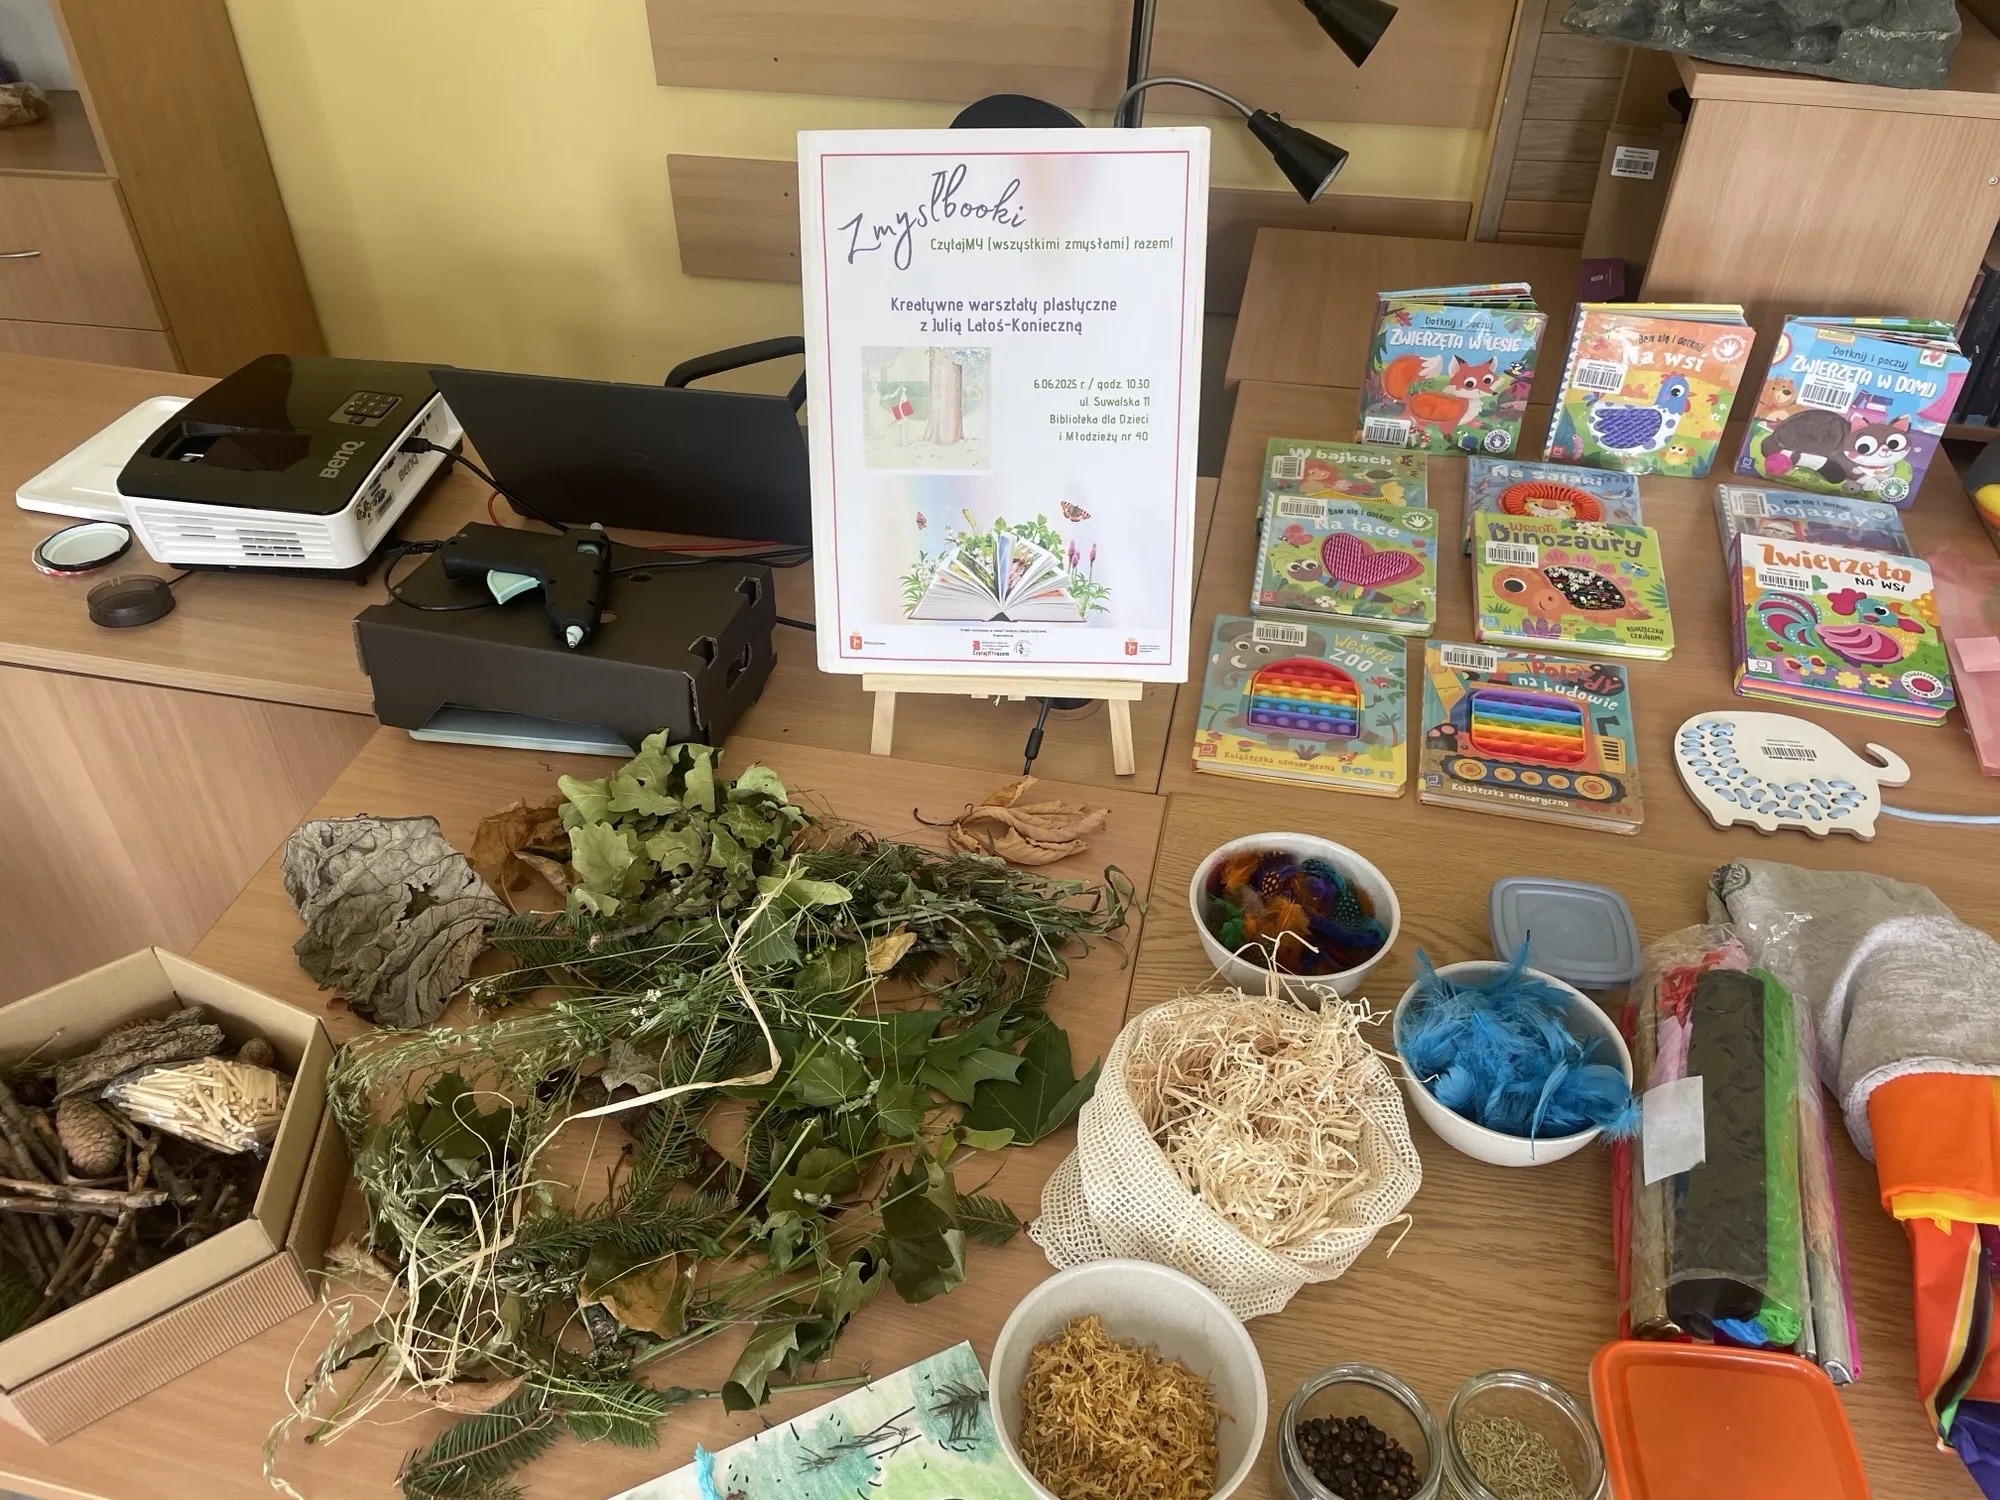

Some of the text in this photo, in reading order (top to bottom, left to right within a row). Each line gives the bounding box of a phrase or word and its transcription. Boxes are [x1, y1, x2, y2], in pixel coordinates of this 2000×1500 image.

[930, 236, 1174, 253] CzytajMY (wszystkimi zmysłami) razem!
[890, 297, 1118, 316] Kreatywne warsztaty plastyczne
[920, 318, 1083, 336] z Julią Latoś-Konieczną
[1425, 316, 1494, 331] Dotknij i poczuj
[1390, 328, 1463, 351] ZWIERZĘTA
[1486, 337, 1522, 352] LESIE
[1657, 334, 1669, 344] się
[1622, 347, 1708, 373] Na wsi
[1833, 346, 1910, 371] Dotknij i poczuj
[1087, 377, 1095, 391] /
[1877, 374, 1893, 390] W
[1895, 375, 1938, 399] DOMU
[1094, 396, 1140, 407] Suwalska
[1143, 396, 1151, 407] 11
[1049, 413, 1149, 424] Biblioteka dla Dzieci
[1058, 431, 1149, 443] i Młodzieży nr 40
[318, 440, 366, 479] BenQ
[1316, 449, 1392, 466] bajkach
[398, 453, 420, 483] BenQ
[1491, 464, 1524, 478] Na
[1313, 516, 1344, 531] Na
[1351, 516, 1400, 538] łące
[1488, 522, 1642, 558] Dinozaury
[1757, 543, 1912, 584] Zwierzęta
[1855, 577, 1875, 587] NA
[1518, 676, 1619, 711] na budowie
[1224, 751, 1396, 780] Książeczka sensoryczna POP IT
[1451, 782, 1505, 798] Książeczka
[1509, 791, 1569, 808] sensoryczna
